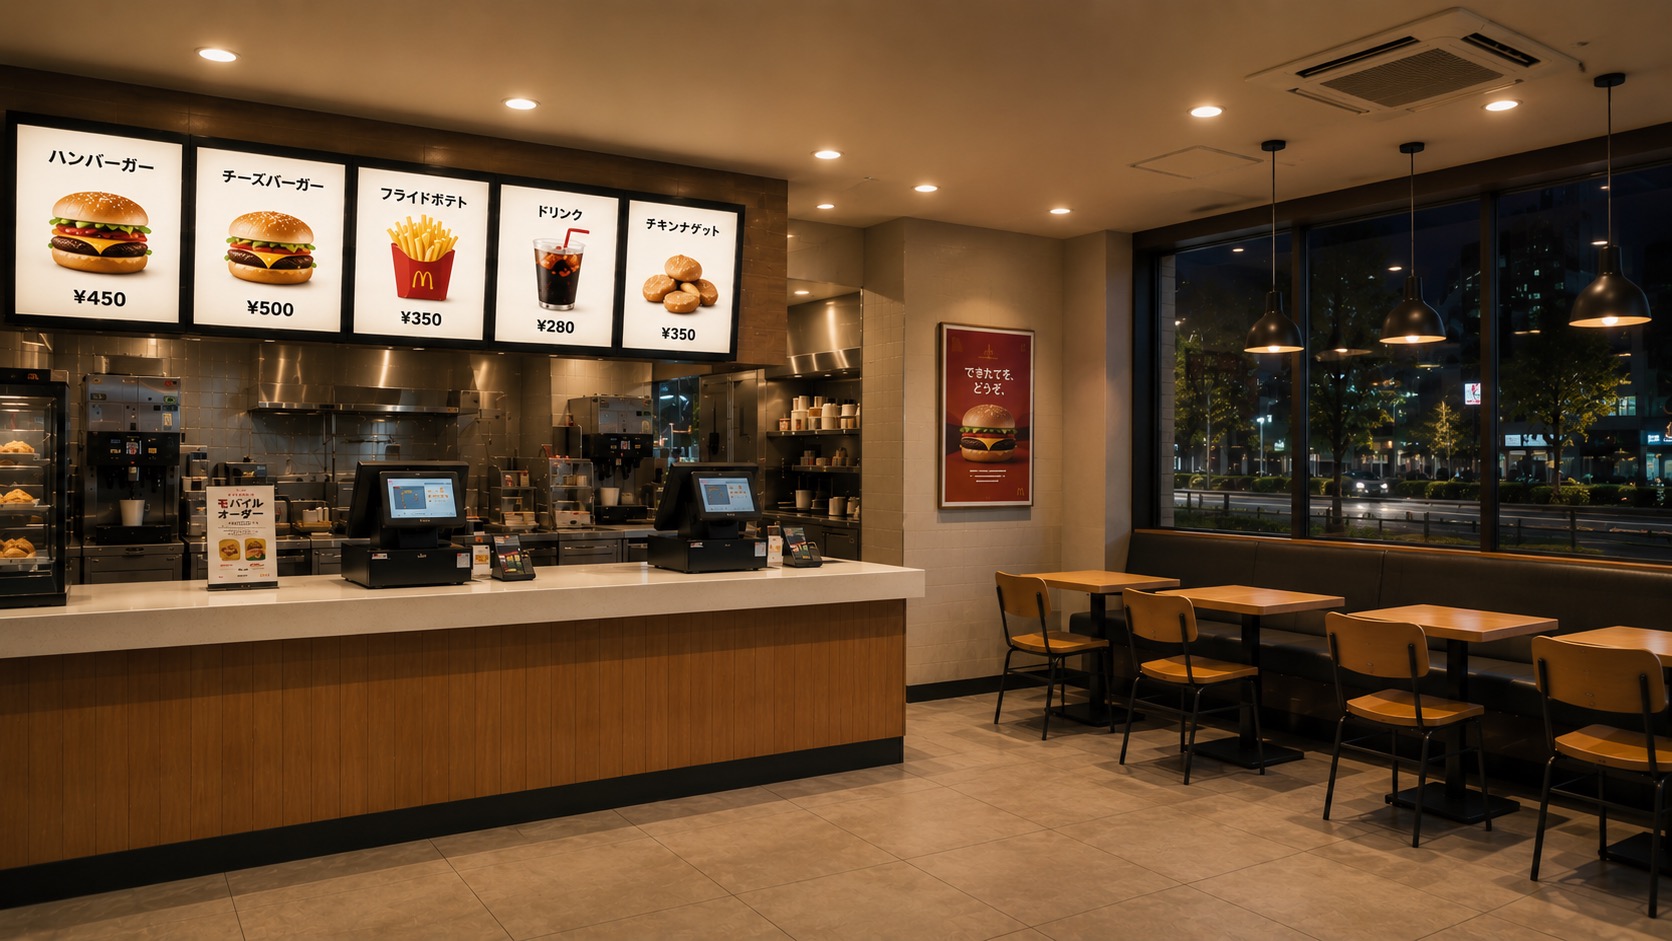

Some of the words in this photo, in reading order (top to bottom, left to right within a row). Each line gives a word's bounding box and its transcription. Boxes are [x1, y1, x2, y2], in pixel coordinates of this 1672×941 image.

[49, 149, 154, 173] ハンバーガー
[222, 169, 324, 192] チーズバーガー
[380, 187, 467, 209] フライドポテト
[538, 204, 583, 222] ドリンク
[645, 218, 720, 237] チキンナゲット
[74, 289, 126, 307] ¥450
[247, 300, 294, 317] ¥500
[401, 311, 442, 327] ¥350
[537, 319, 575, 334] ¥280
[661, 327, 696, 341] ¥350
[965, 367, 1014, 381] できたてを、
[218, 498, 264, 509] モバイル
[218, 509, 264, 519] オーダー
